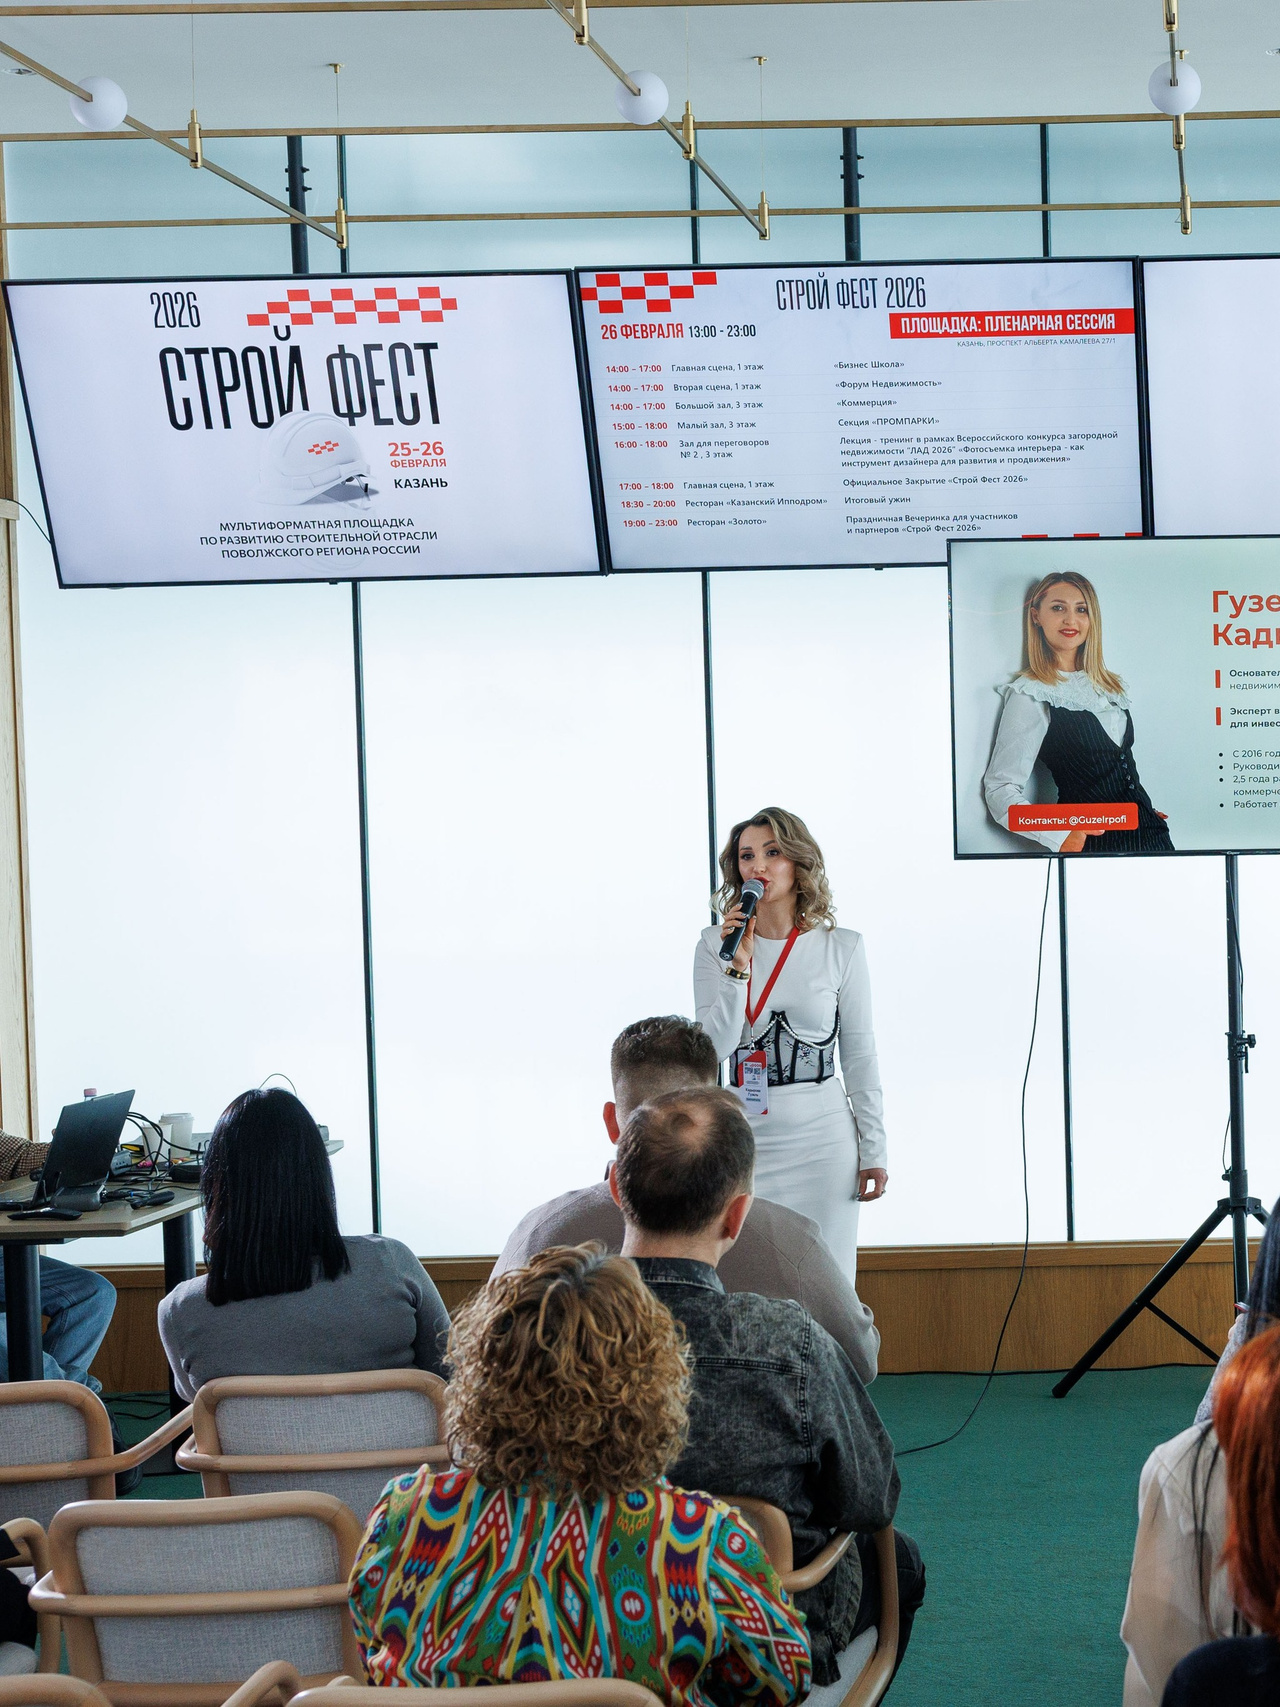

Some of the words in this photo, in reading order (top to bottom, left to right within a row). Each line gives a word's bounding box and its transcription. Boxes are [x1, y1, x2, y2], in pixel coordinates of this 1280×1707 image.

[776, 271, 829, 310] СТРОЙ
[836, 277, 877, 309] ФЕСТ
[884, 276, 926, 308] 2026
[149, 291, 200, 328] 2026
[901, 316, 982, 335] ПЛОЩАДКА:
[984, 314, 1063, 332] ПЛЕНАРНАЯ
[1066, 313, 1116, 331] СЕССИЯ
[600, 324, 618, 340] 26
[620, 322, 684, 340] ФЕВРАЛЯ
[688, 324, 717, 339] 13:00
[726, 324, 757, 338] 23:00
[957, 340, 986, 348] КАЗАНЬ,
[986, 339, 1023, 347] ПРОСПЕКТ
[1023, 338, 1059, 346] АЛЬБЕРТА
[1059, 337, 1101, 345] КАМАЛЕЕВА
[1101, 337, 1116, 345] 27/1
[671, 364, 707, 372] Главная
[707, 364, 736, 373] сцена,
[737, 363, 742, 371] 1
[833, 361, 869, 370] «Бизнес
[870, 360, 905, 369] Школа»
[158, 324, 310, 431] СТРОЙ
[325, 341, 440, 426] ФЕСТ
[835, 380, 870, 391] «Форум
[871, 380, 943, 389] Недвижимость»
[836, 399, 898, 409] «Коммерция»
[838, 418, 870, 428] Секция
[871, 417, 940, 426] «ПРОМПАРКИ»
[388, 441, 445, 457] 25-26
[390, 458, 447, 469] ФЕВРАЛЯ
[393, 477, 449, 489] КАЗАНЬ
[842, 478, 903, 489] Официальное
[905, 477, 947, 487] Закрытие
[947, 475, 979, 486] «Строй
[980, 475, 1001, 484] Фест
[1003, 474, 1029, 483] 2026»
[685, 499, 724, 509] Ресторан
[726, 497, 776, 507] «Казанский
[777, 497, 828, 507] Ипподром»
[844, 495, 887, 504] Итоговый
[888, 497, 911, 506] ужин
[219, 519, 342, 532] МУЛЬТИФОРМАТНАЯ
[343, 518, 415, 529] ПЛОЩАДКА
[687, 518, 726, 528] Ресторан
[728, 517, 767, 526] «Золото»
[199, 536, 218, 546] ПО
[219, 534, 285, 546] РАЗВИТИЮ
[286, 530, 381, 544] СТРОИТЕЛЬНОЙ
[382, 531, 438, 542] ОТРАСЛИ
[221, 547, 315, 559] ПОВОЛЖСКОГО
[315, 546, 371, 557] РЕГИОНА
[371, 545, 421, 555] РОССИИ
[1230, 707, 1272, 717] Эксперт
[1229, 721, 1249, 729] для
[1232, 749, 1240, 759] С
[1241, 749, 1263, 758] 2016
[1232, 774, 1247, 784] 2,5
[1248, 776, 1270, 784] года
[1233, 799, 1278, 809] Работает
[1018, 817, 1068, 825] Контакты:
